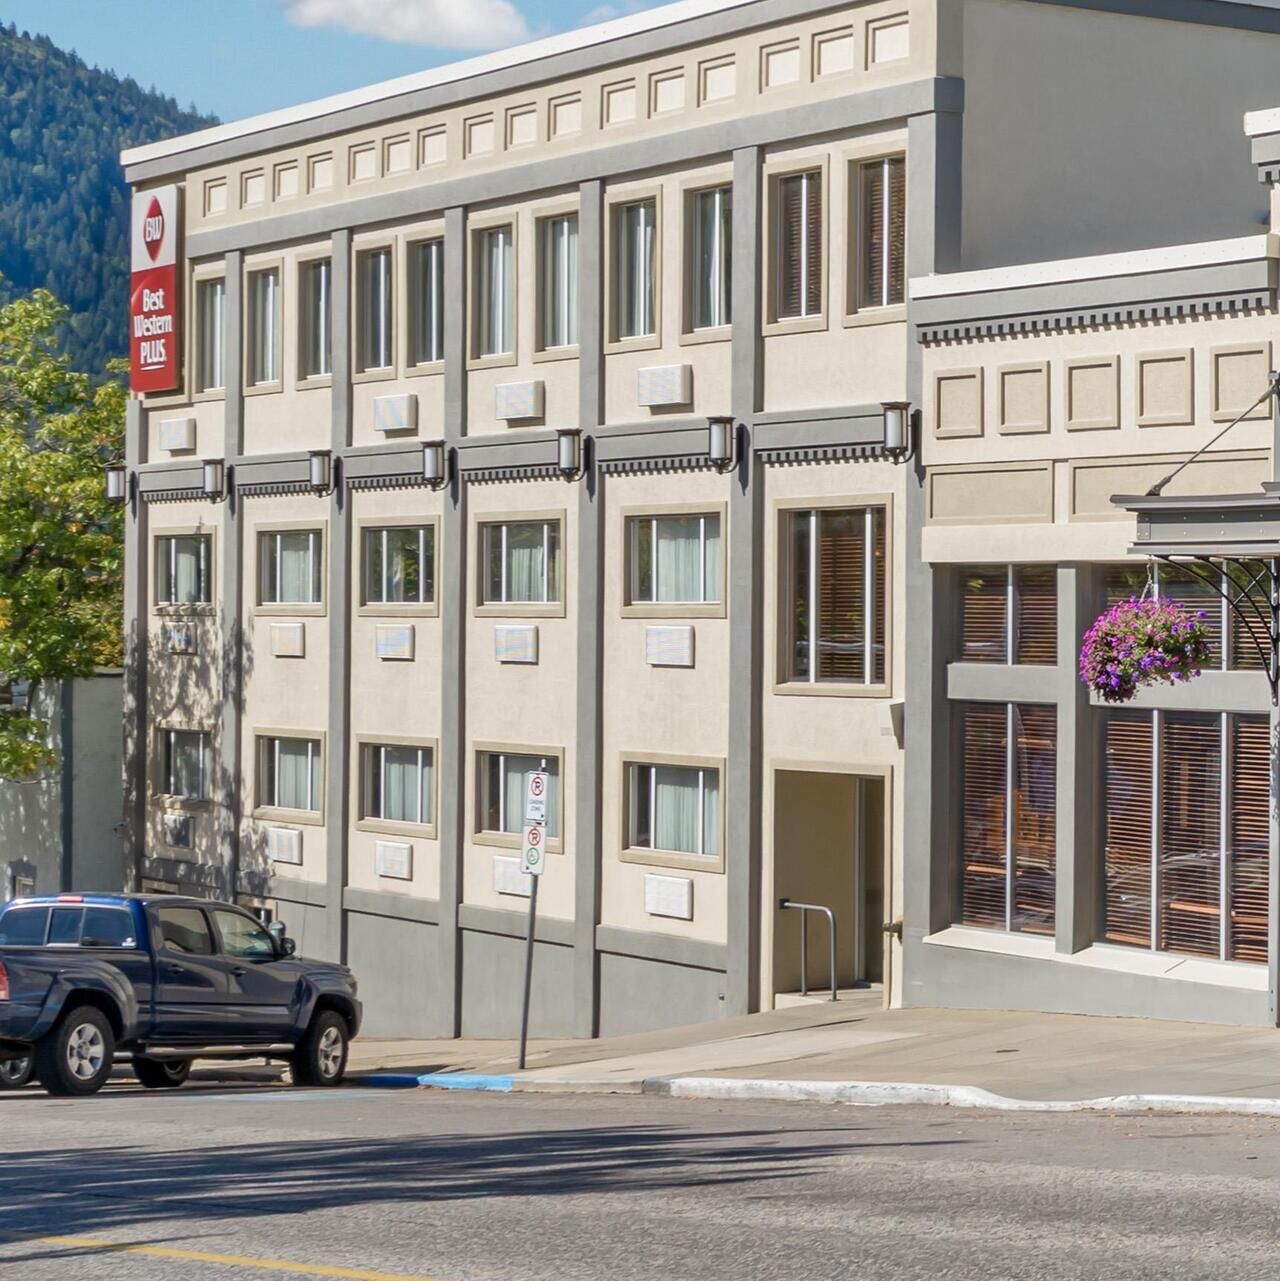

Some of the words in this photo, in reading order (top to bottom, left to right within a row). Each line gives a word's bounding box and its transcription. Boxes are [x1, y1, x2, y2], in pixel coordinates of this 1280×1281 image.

[145, 215, 163, 242] BW
[143, 288, 165, 312] Best
[133, 314, 173, 338] Western
[140, 339, 165, 365] PLUS
